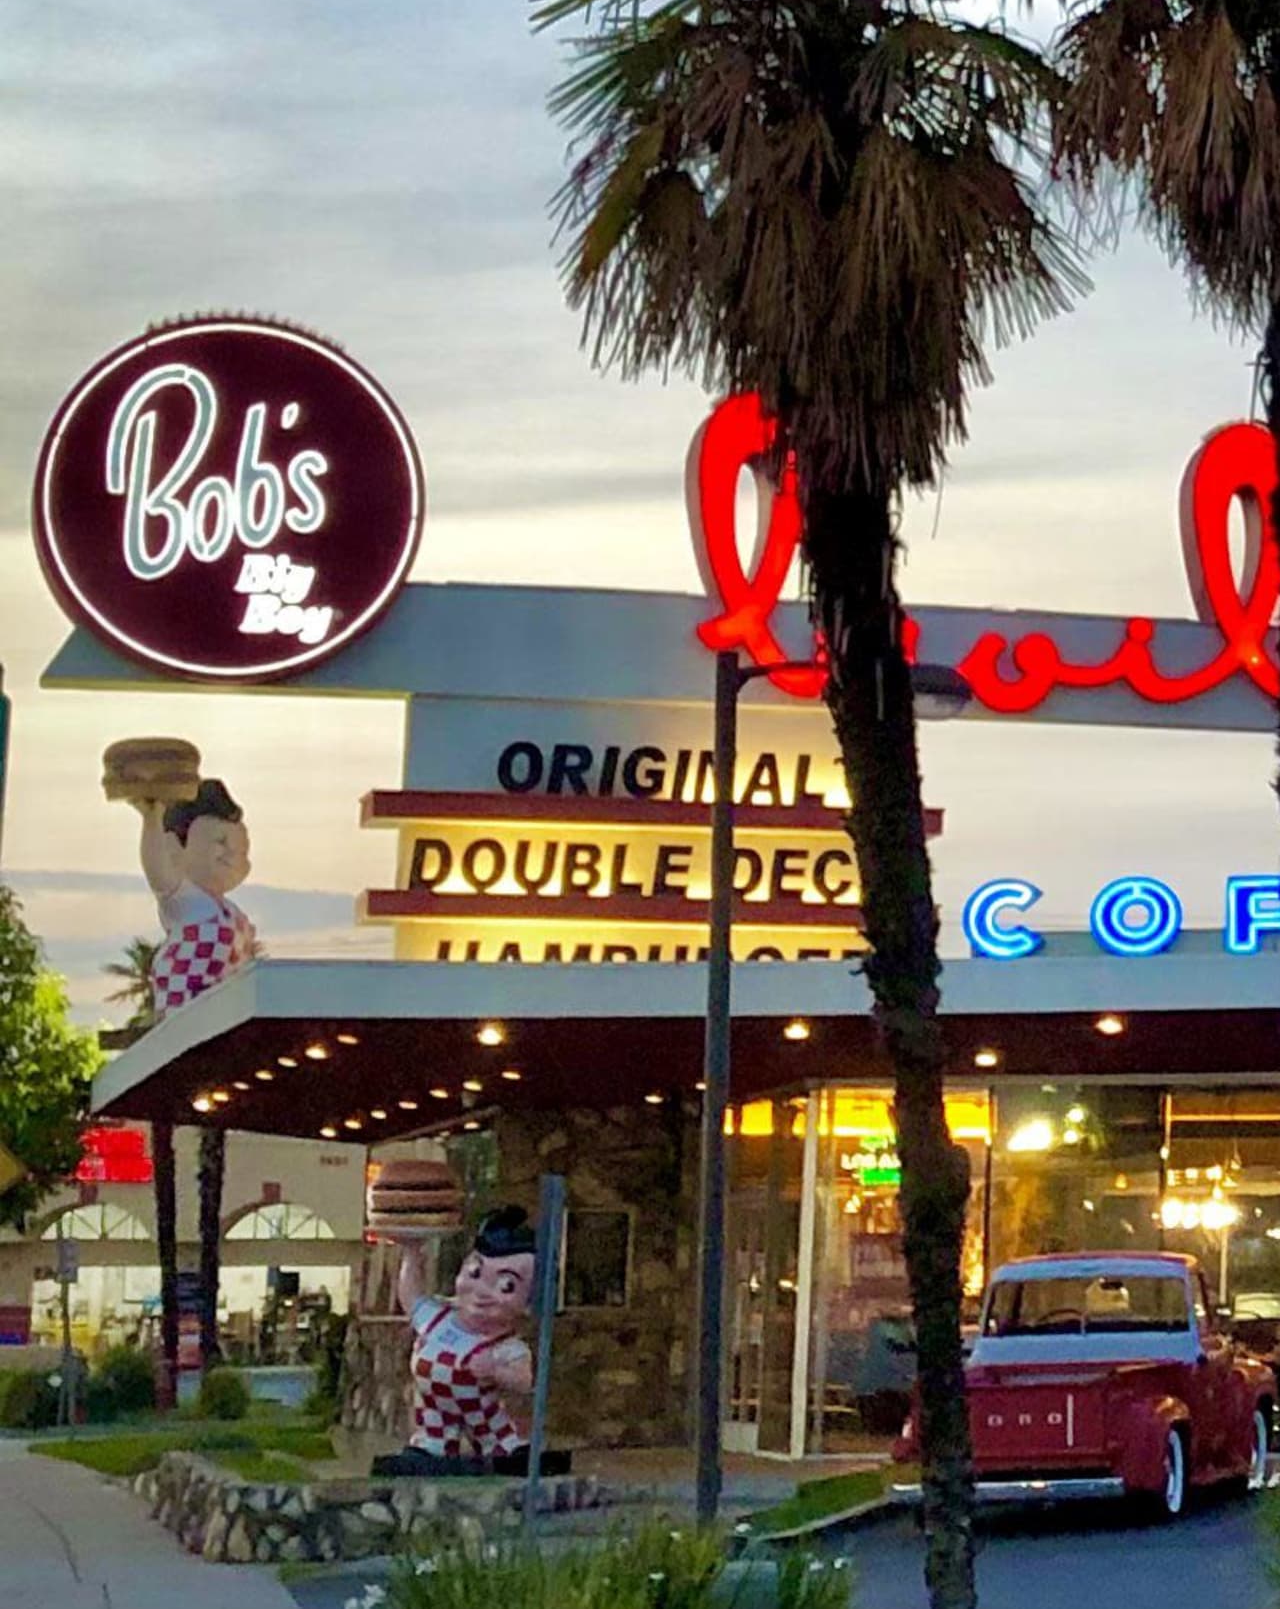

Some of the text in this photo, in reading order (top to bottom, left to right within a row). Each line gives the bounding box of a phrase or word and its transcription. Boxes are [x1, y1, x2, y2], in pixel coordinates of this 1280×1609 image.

[105, 362, 329, 581] Bob's
[233, 553, 316, 605] Big
[237, 593, 334, 645] Boy
[496, 740, 826, 801] ORIGINAL
[409, 837, 853, 899] DOUBLE DEC
